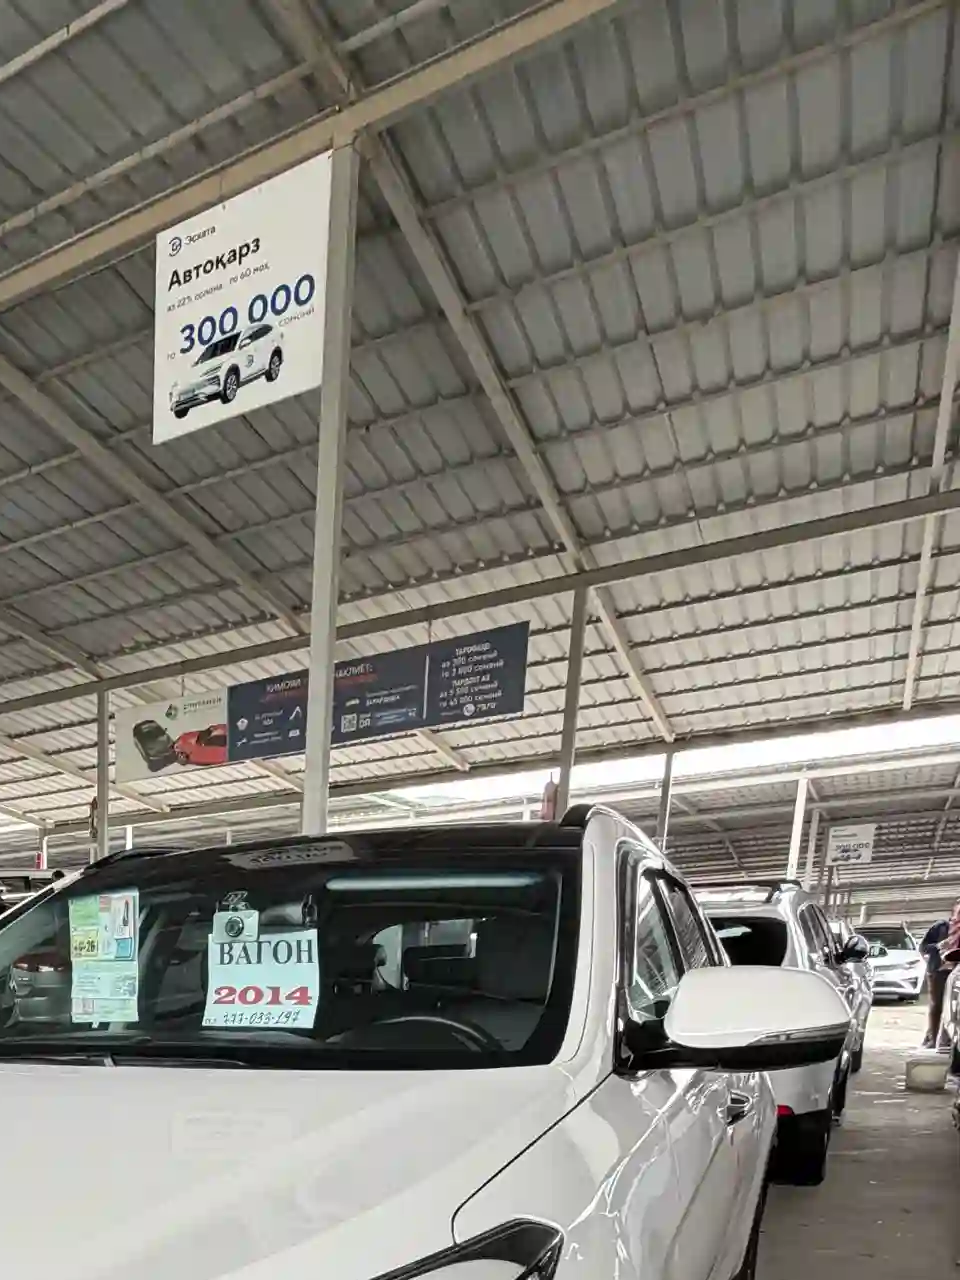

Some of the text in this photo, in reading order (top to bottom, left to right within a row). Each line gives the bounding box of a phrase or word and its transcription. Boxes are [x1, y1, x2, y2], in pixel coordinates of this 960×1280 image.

[180, 306, 238, 354] 300
[248, 273, 316, 325] 000
[218, 938, 315, 966] ВАГОН
[212, 985, 313, 1006] 2014
